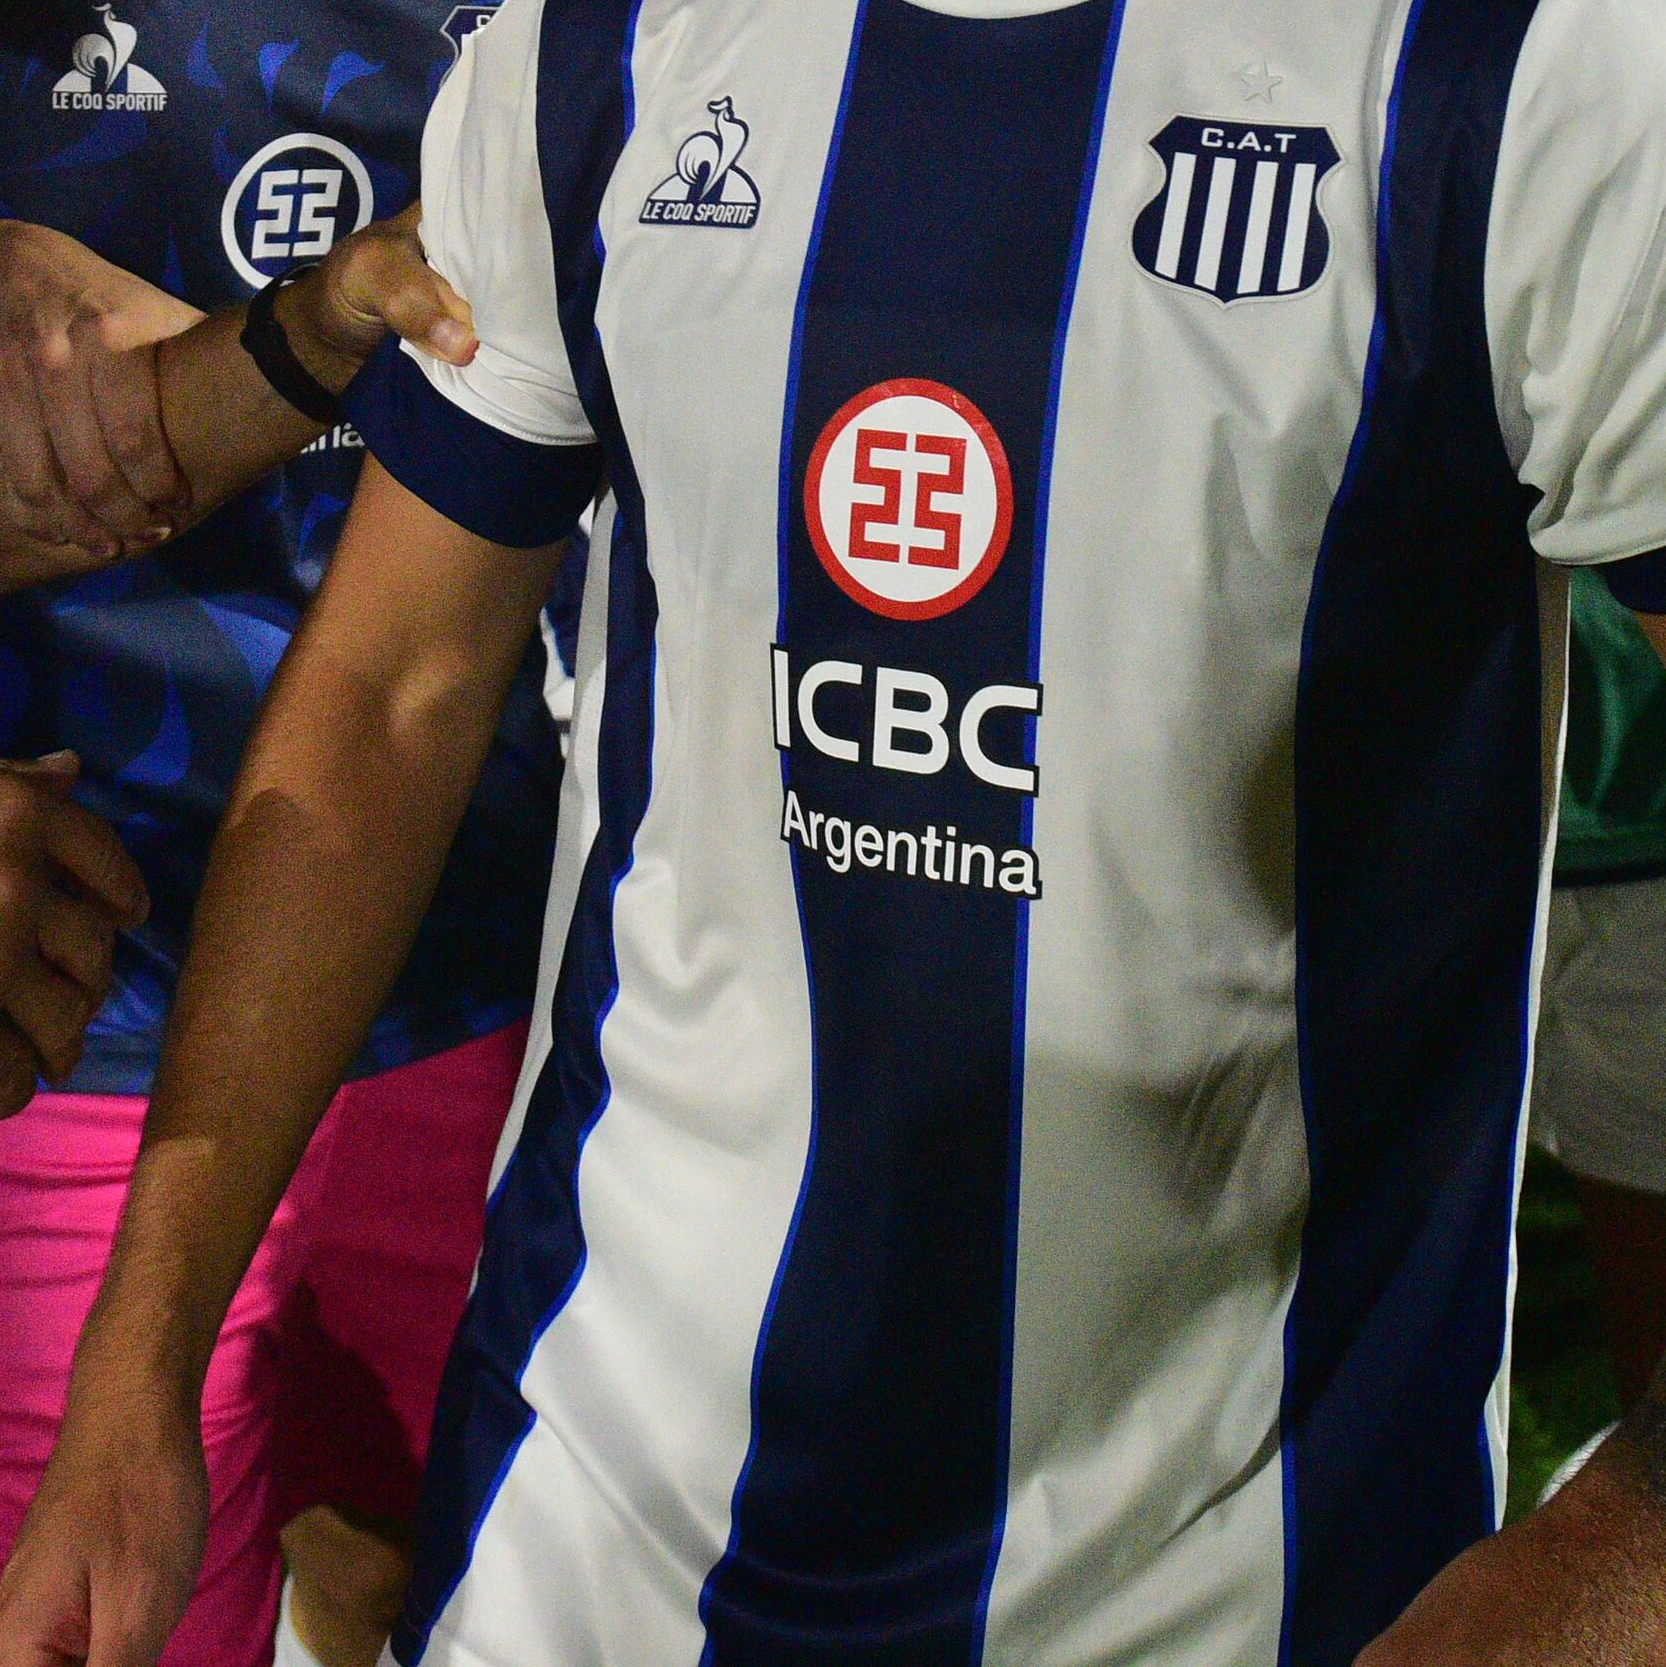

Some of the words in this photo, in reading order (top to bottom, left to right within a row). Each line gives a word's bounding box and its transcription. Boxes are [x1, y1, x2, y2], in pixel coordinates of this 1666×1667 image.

[52, 93, 70, 110] LE
[72, 93, 103, 110] COQ
[105, 94, 168, 111] SPORTIF
[1200, 126, 1298, 154] C.A.T
[642, 201, 664, 220] LE
[662, 202, 694, 221] COQ
[694, 203, 756, 224] SPORTIF
[774, 649, 1039, 790] ICBC
[783, 793, 1039, 894] Argentina
